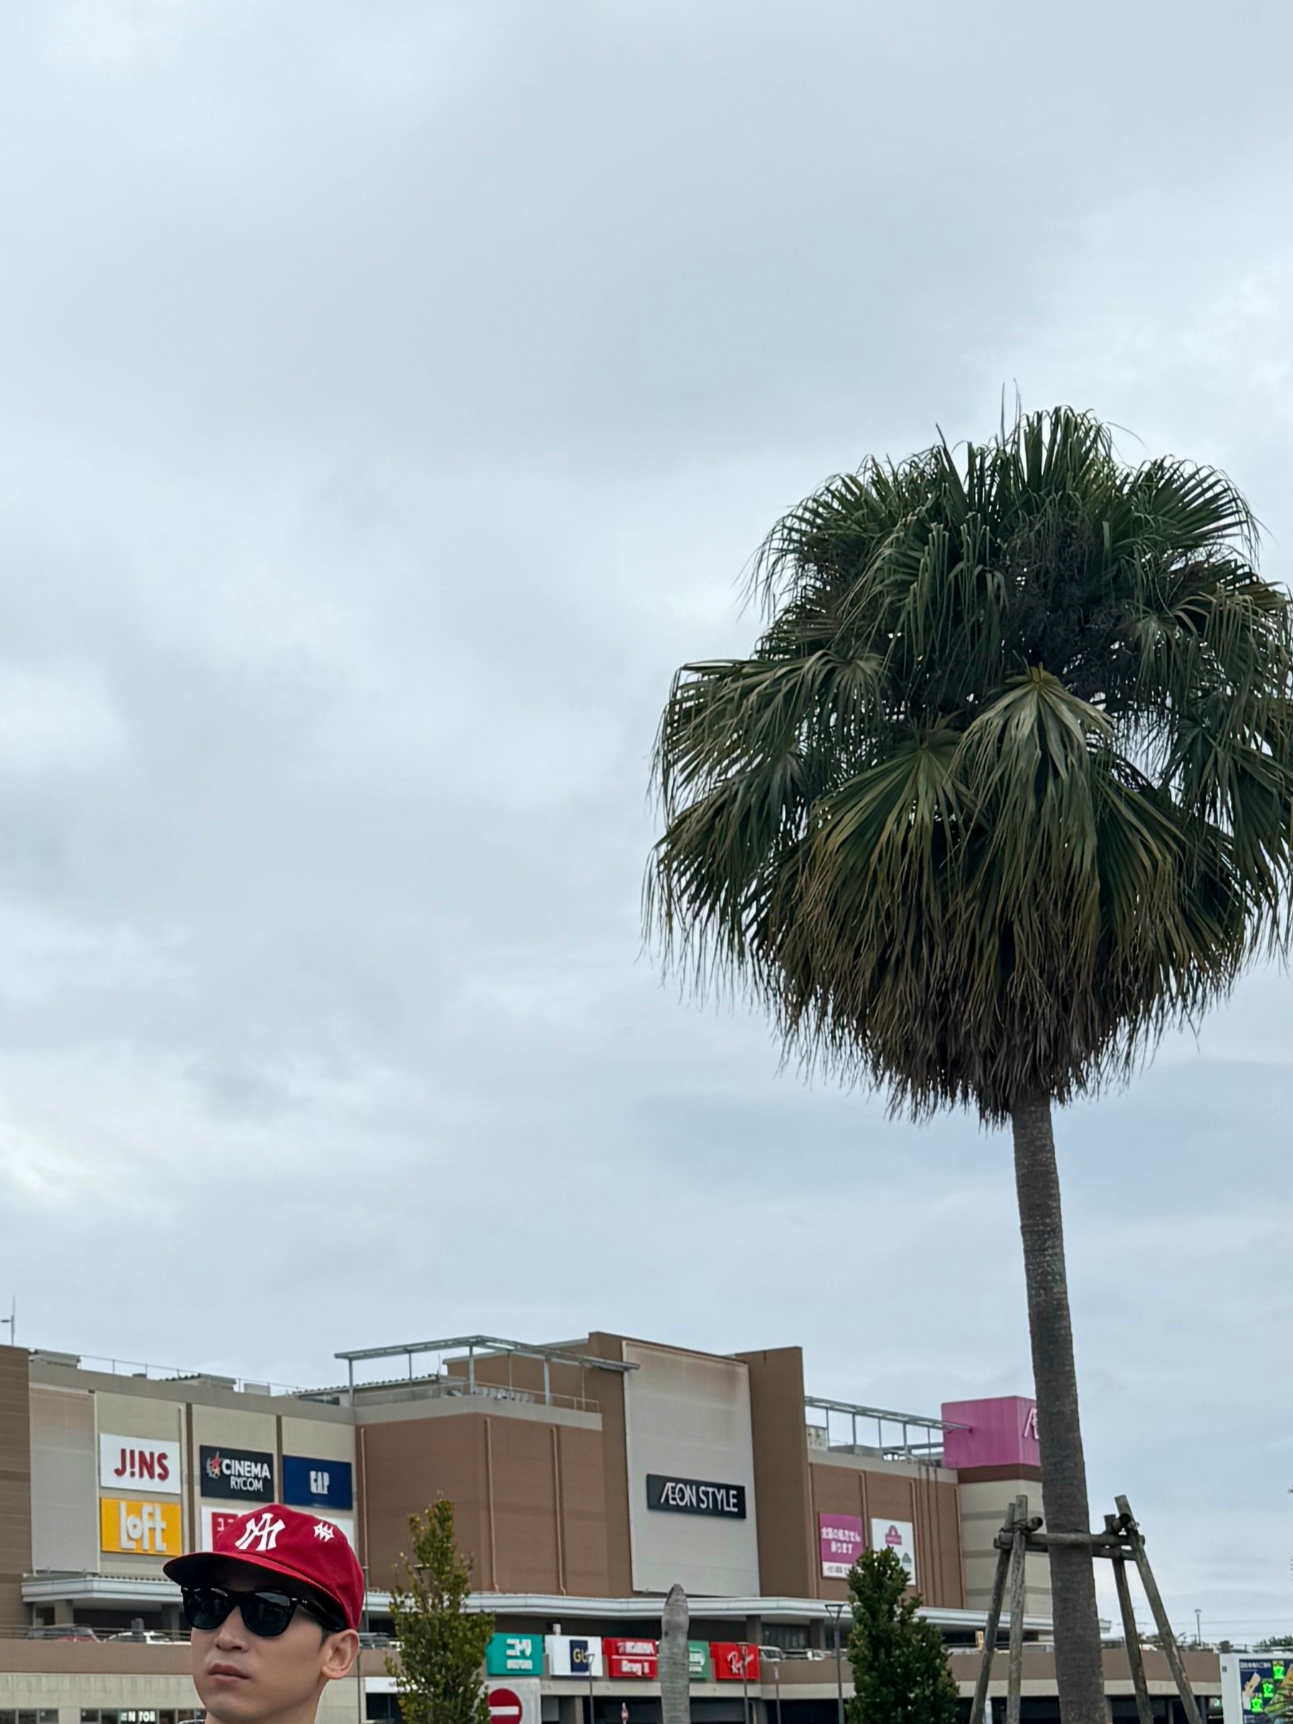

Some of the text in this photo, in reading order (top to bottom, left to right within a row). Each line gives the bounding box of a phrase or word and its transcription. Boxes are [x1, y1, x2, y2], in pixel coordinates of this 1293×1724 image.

[221, 1458, 272, 1480] CINEMA
[229, 1475, 264, 1493] RYCOM
[309, 1470, 330, 1494] GAP
[699, 1485, 739, 1513] STYLE
